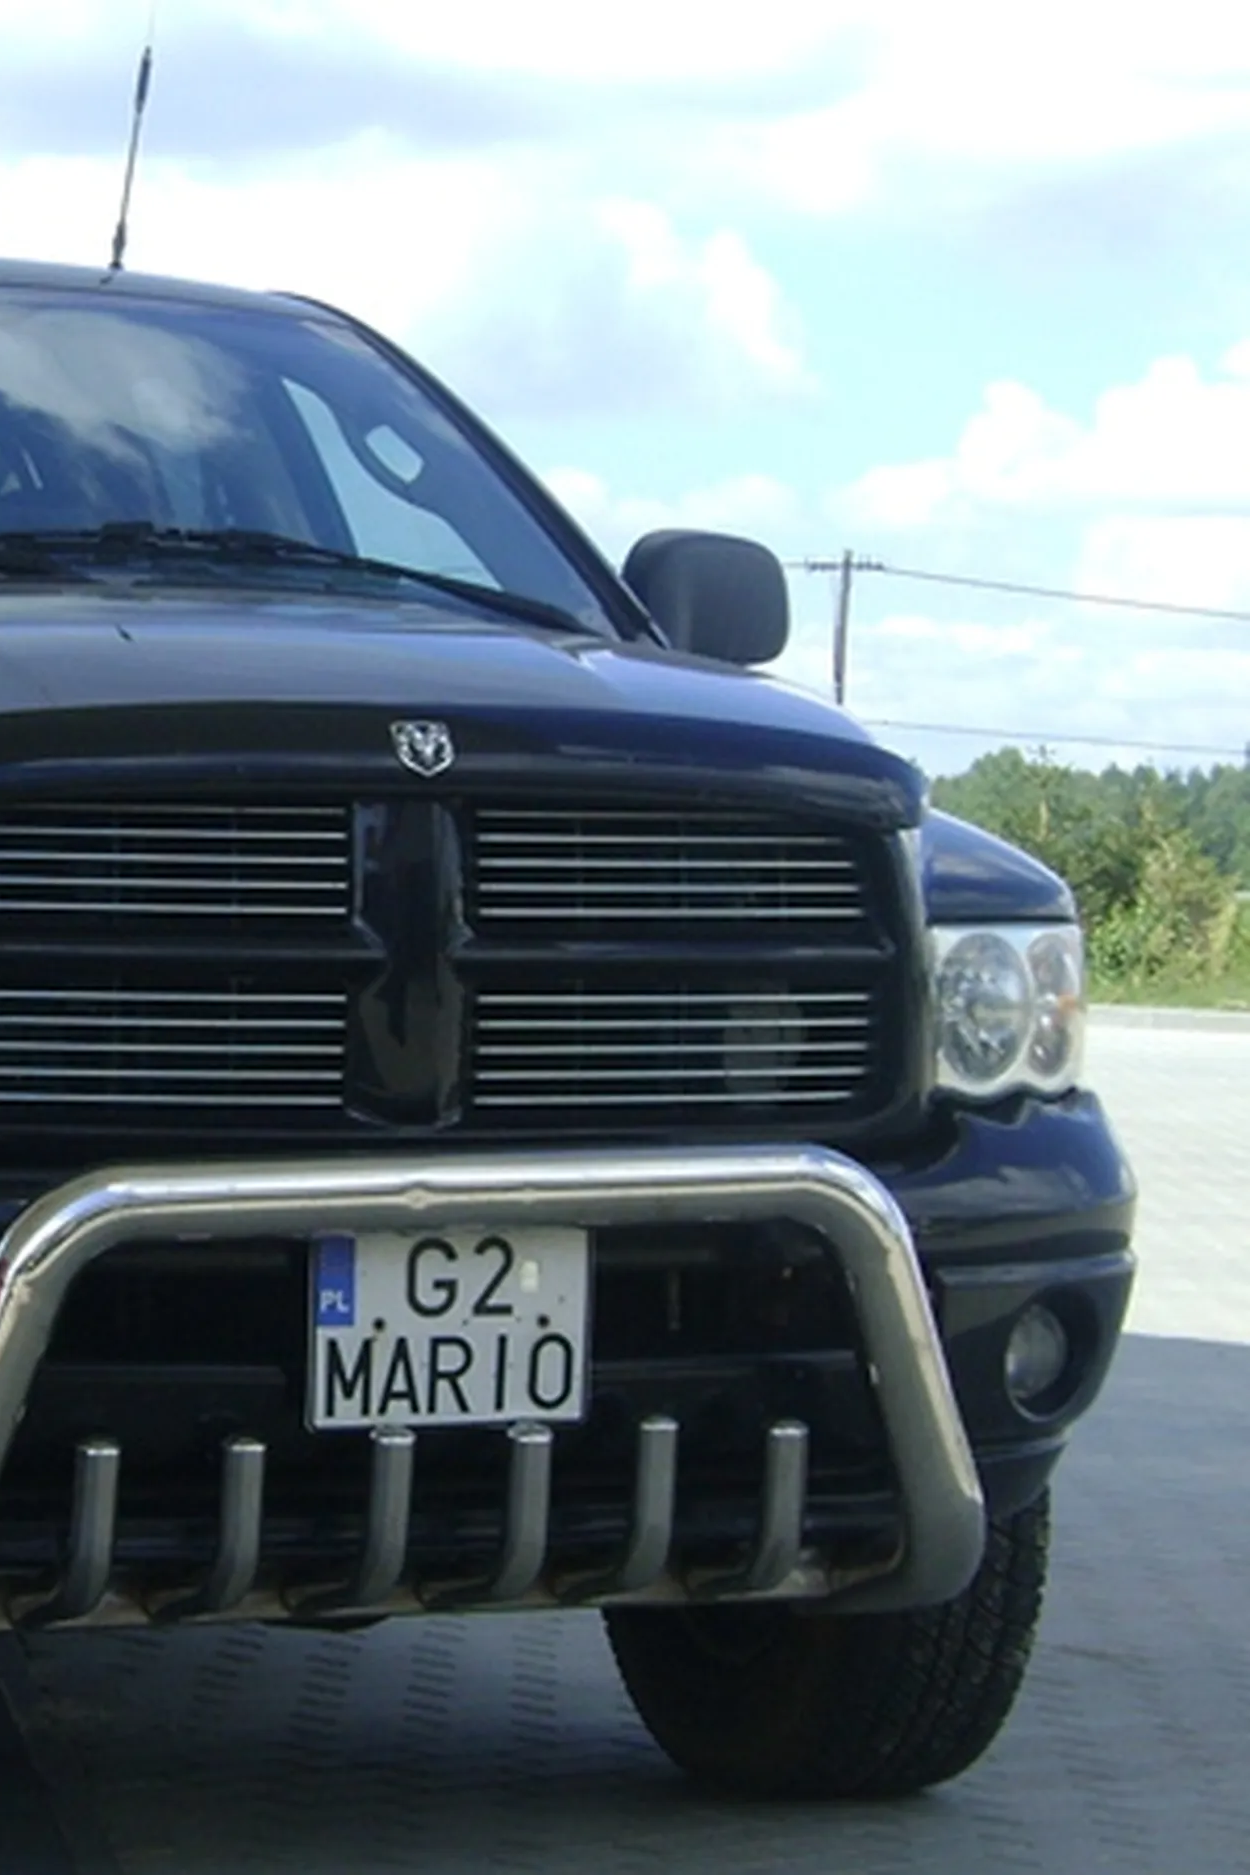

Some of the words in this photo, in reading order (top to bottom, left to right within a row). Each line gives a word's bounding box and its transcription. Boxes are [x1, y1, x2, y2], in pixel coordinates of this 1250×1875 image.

[319, 1290, 350, 1313] PL
[406, 1235, 515, 1318] G2
[325, 1332, 574, 1418] MARIO
